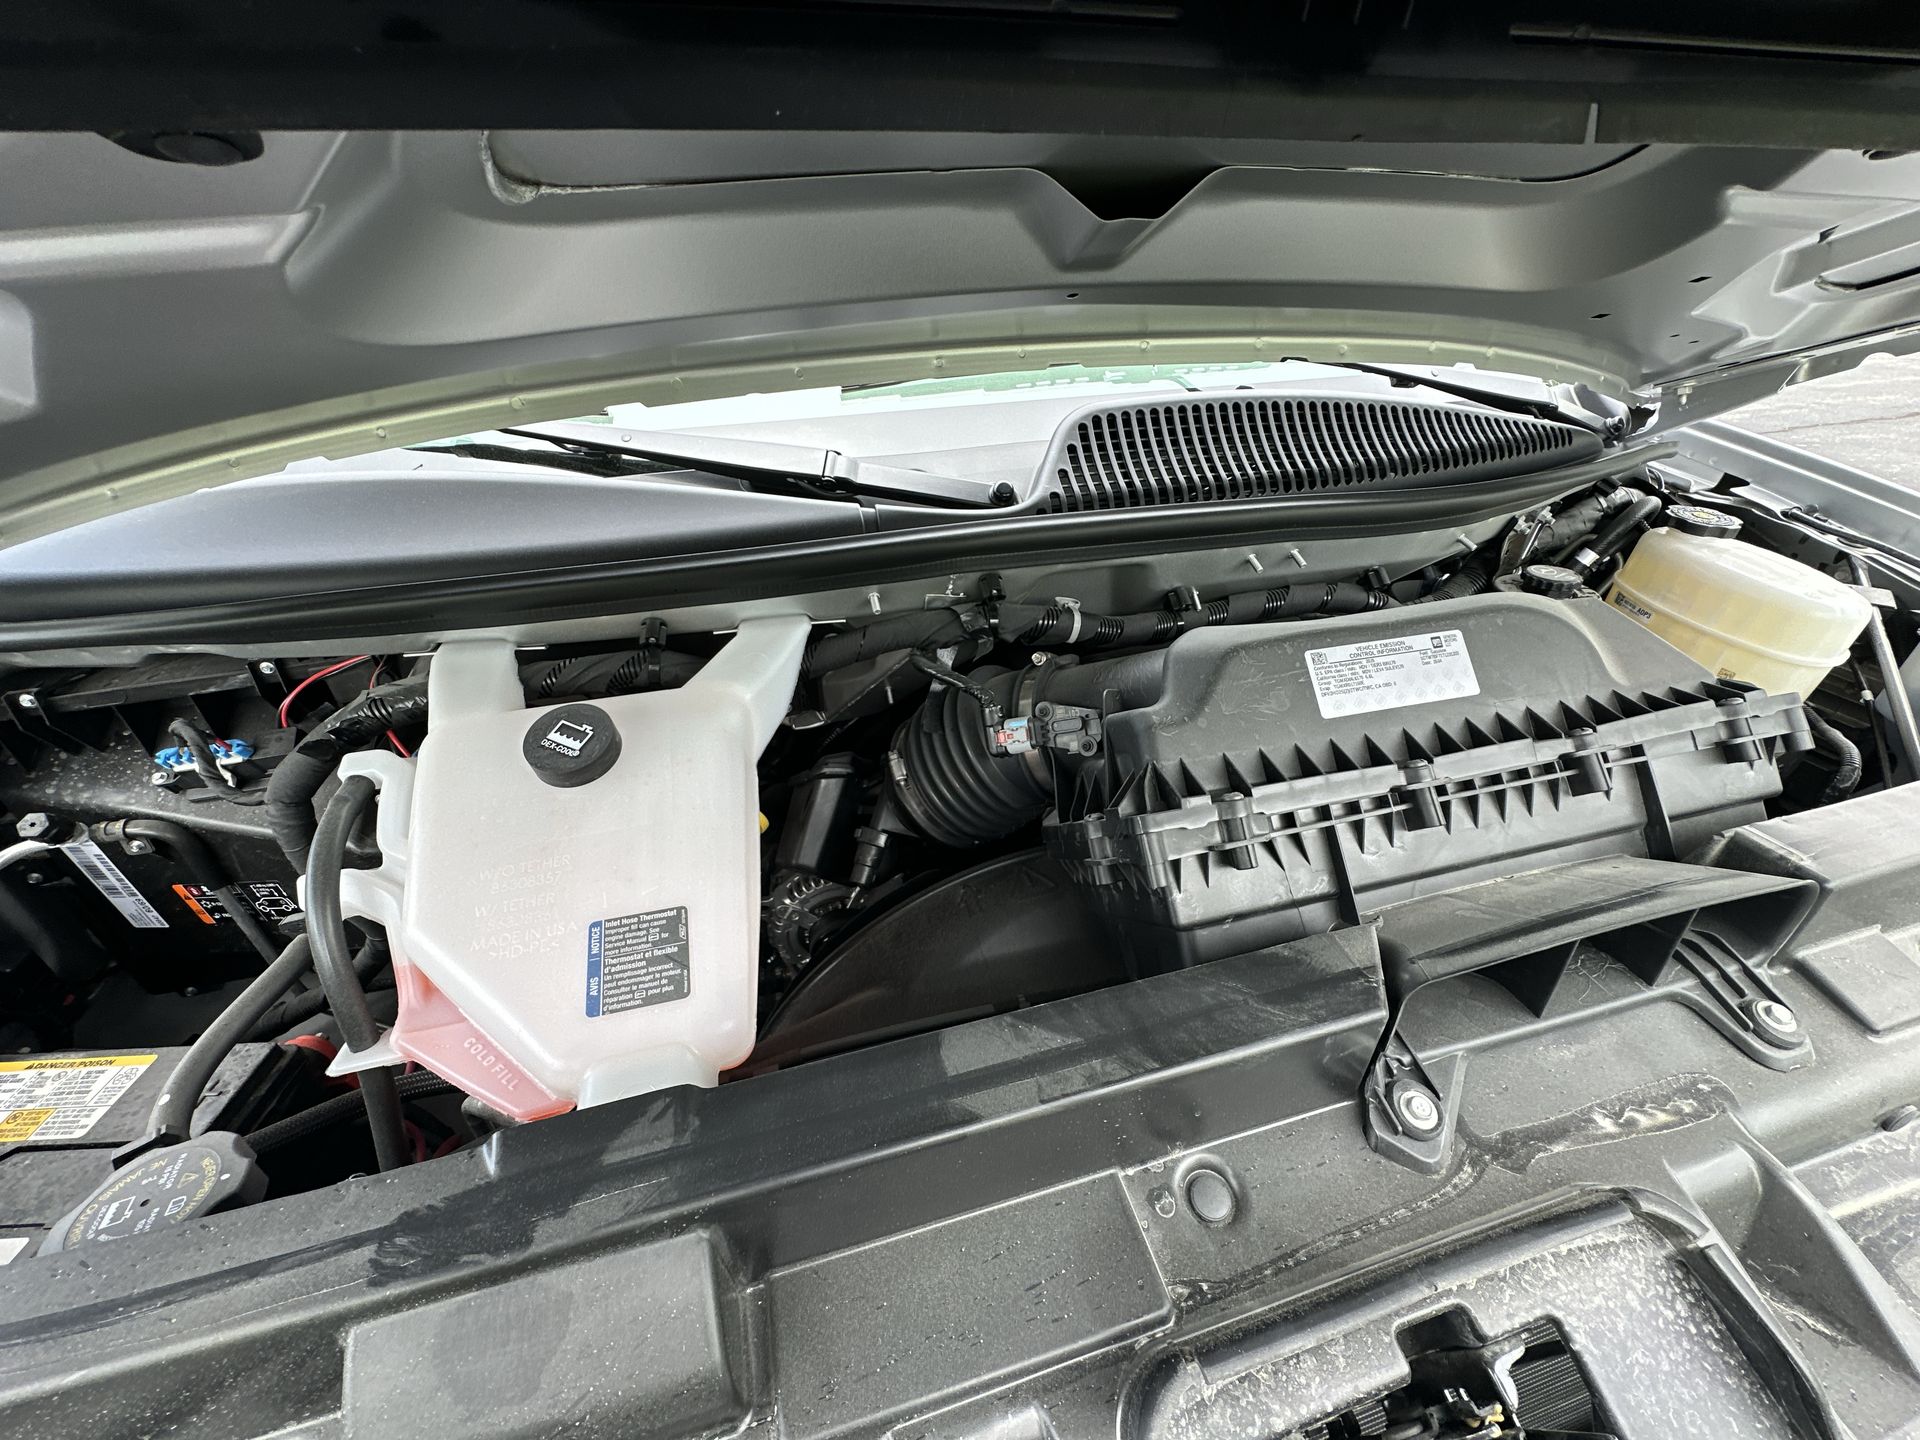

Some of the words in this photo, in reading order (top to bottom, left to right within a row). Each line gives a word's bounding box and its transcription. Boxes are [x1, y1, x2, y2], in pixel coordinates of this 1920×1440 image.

[1355, 644, 1378, 652] VEHICLE
[1379, 640, 1406, 649] EMISSION
[1377, 645, 1414, 654] INFORMATION
[640, 910, 677, 922] Thermostat
[470, 930, 520, 952] MADE
[524, 928, 542, 940] IN
[546, 922, 578, 937] USA
[605, 926, 630, 936] Improper
[605, 934, 624, 942] engine
[591, 926, 600, 954] NOTICE
[605, 941, 626, 949] Service
[626, 936, 648, 945] Manual
[604, 953, 644, 966] Thermostat
[654, 946, 678, 956] flexible
[604, 961, 646, 974] d'admission
[612, 968, 648, 980] remplissage
[648, 962, 674, 972] incorrect
[590, 976, 598, 996] AVIS
[604, 981, 616, 989] peut
[618, 974, 654, 986] endommager
[604, 986, 630, 996] Consulter
[638, 980, 660, 989] manuel
[648, 988, 661, 996] pour
[662, 984, 674, 993] plus
[464, 1037, 496, 1066] COLD
[490, 1064, 519, 1090] FILL
[162, 1152, 188, 1190] RADIATOR
